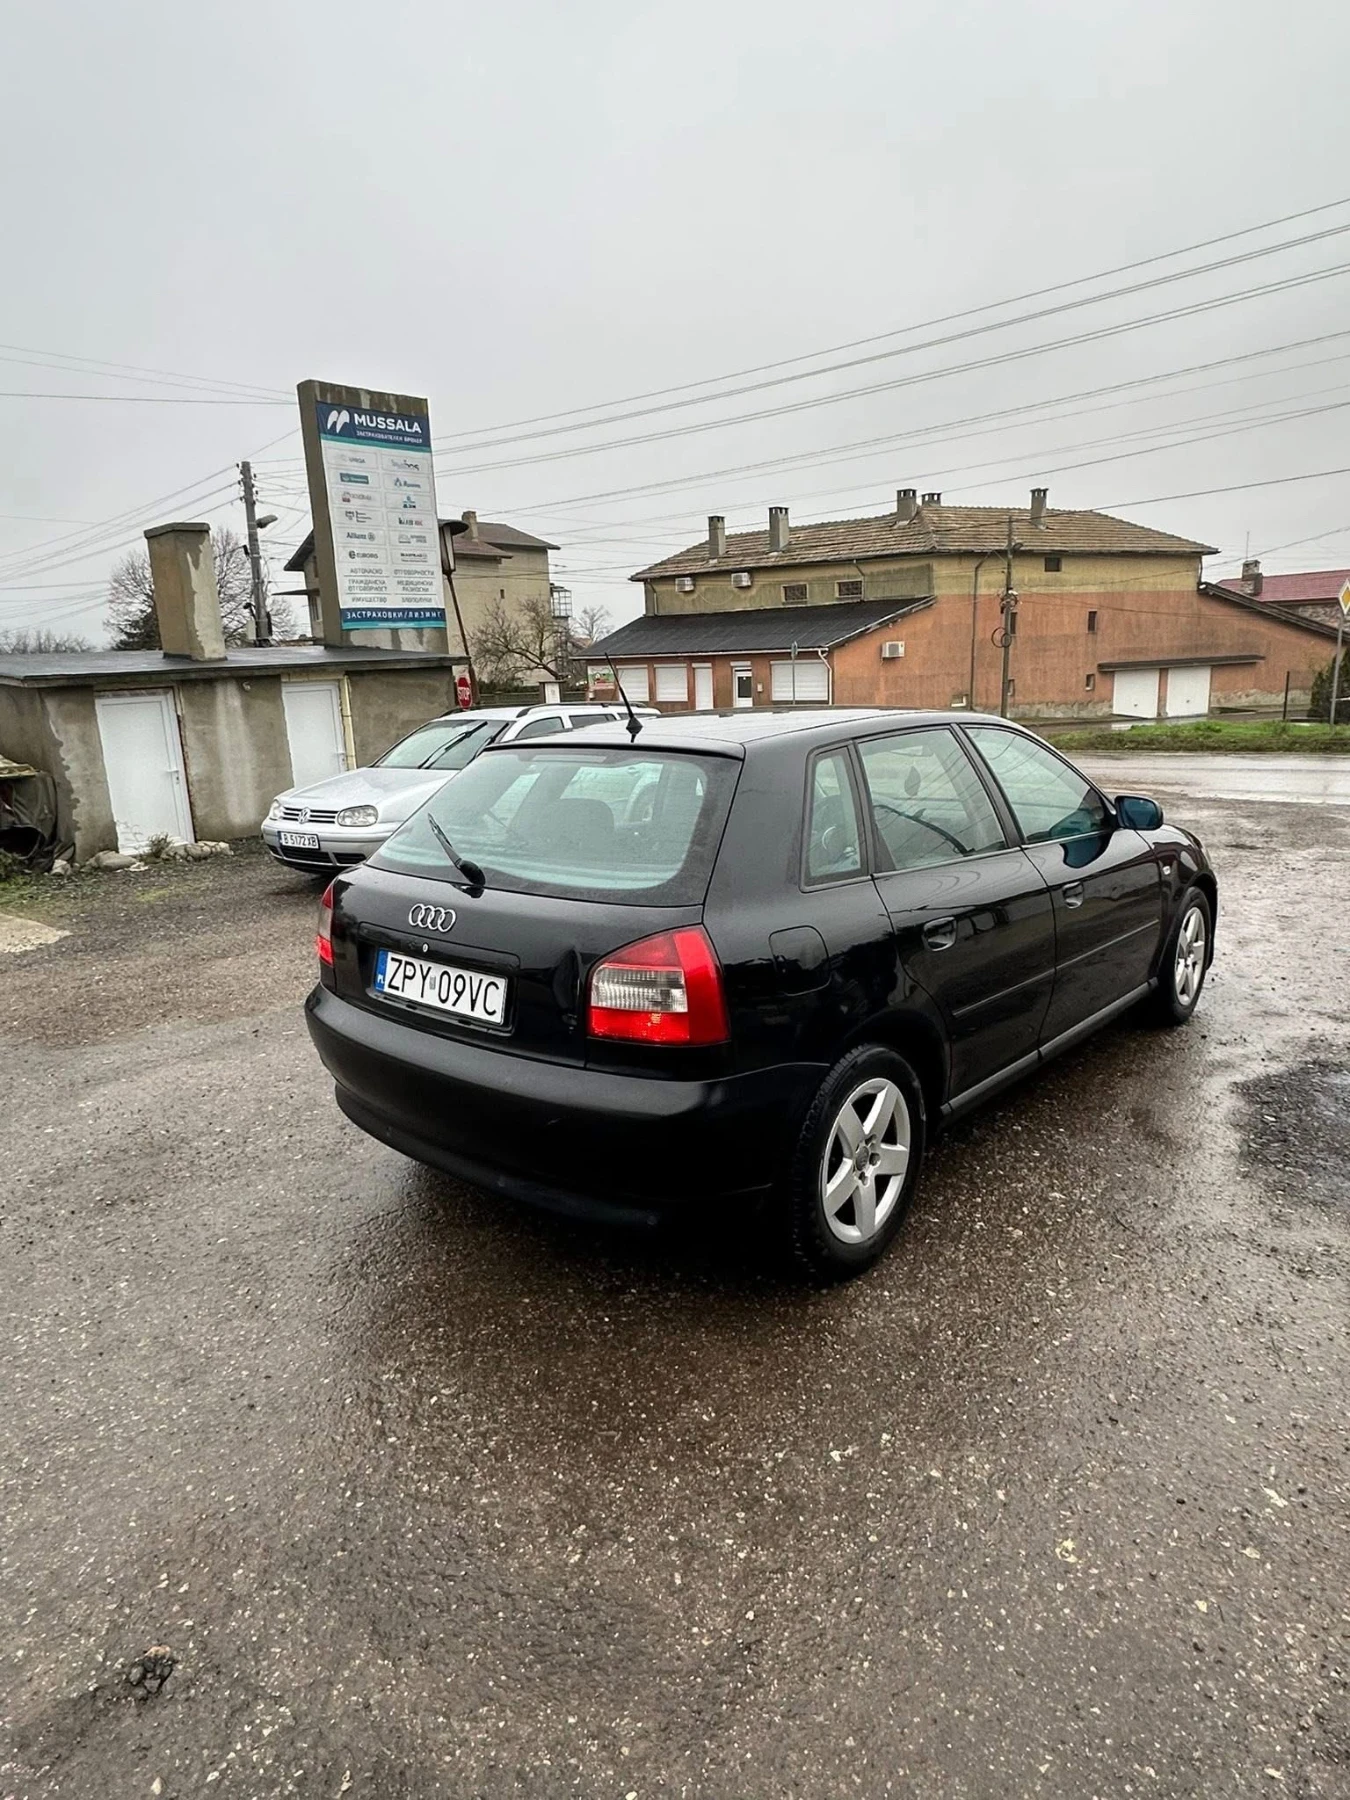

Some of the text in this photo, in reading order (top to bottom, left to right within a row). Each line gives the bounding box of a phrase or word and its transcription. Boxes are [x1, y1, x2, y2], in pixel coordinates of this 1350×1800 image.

[354, 413, 422, 433] MUSSALA
[346, 611, 442, 619] ЗАСТРАХОВКИ/ЛИЗИНГ
[290, 834, 307, 846] 5172
[387, 957, 500, 1016] ZPY 09VC
